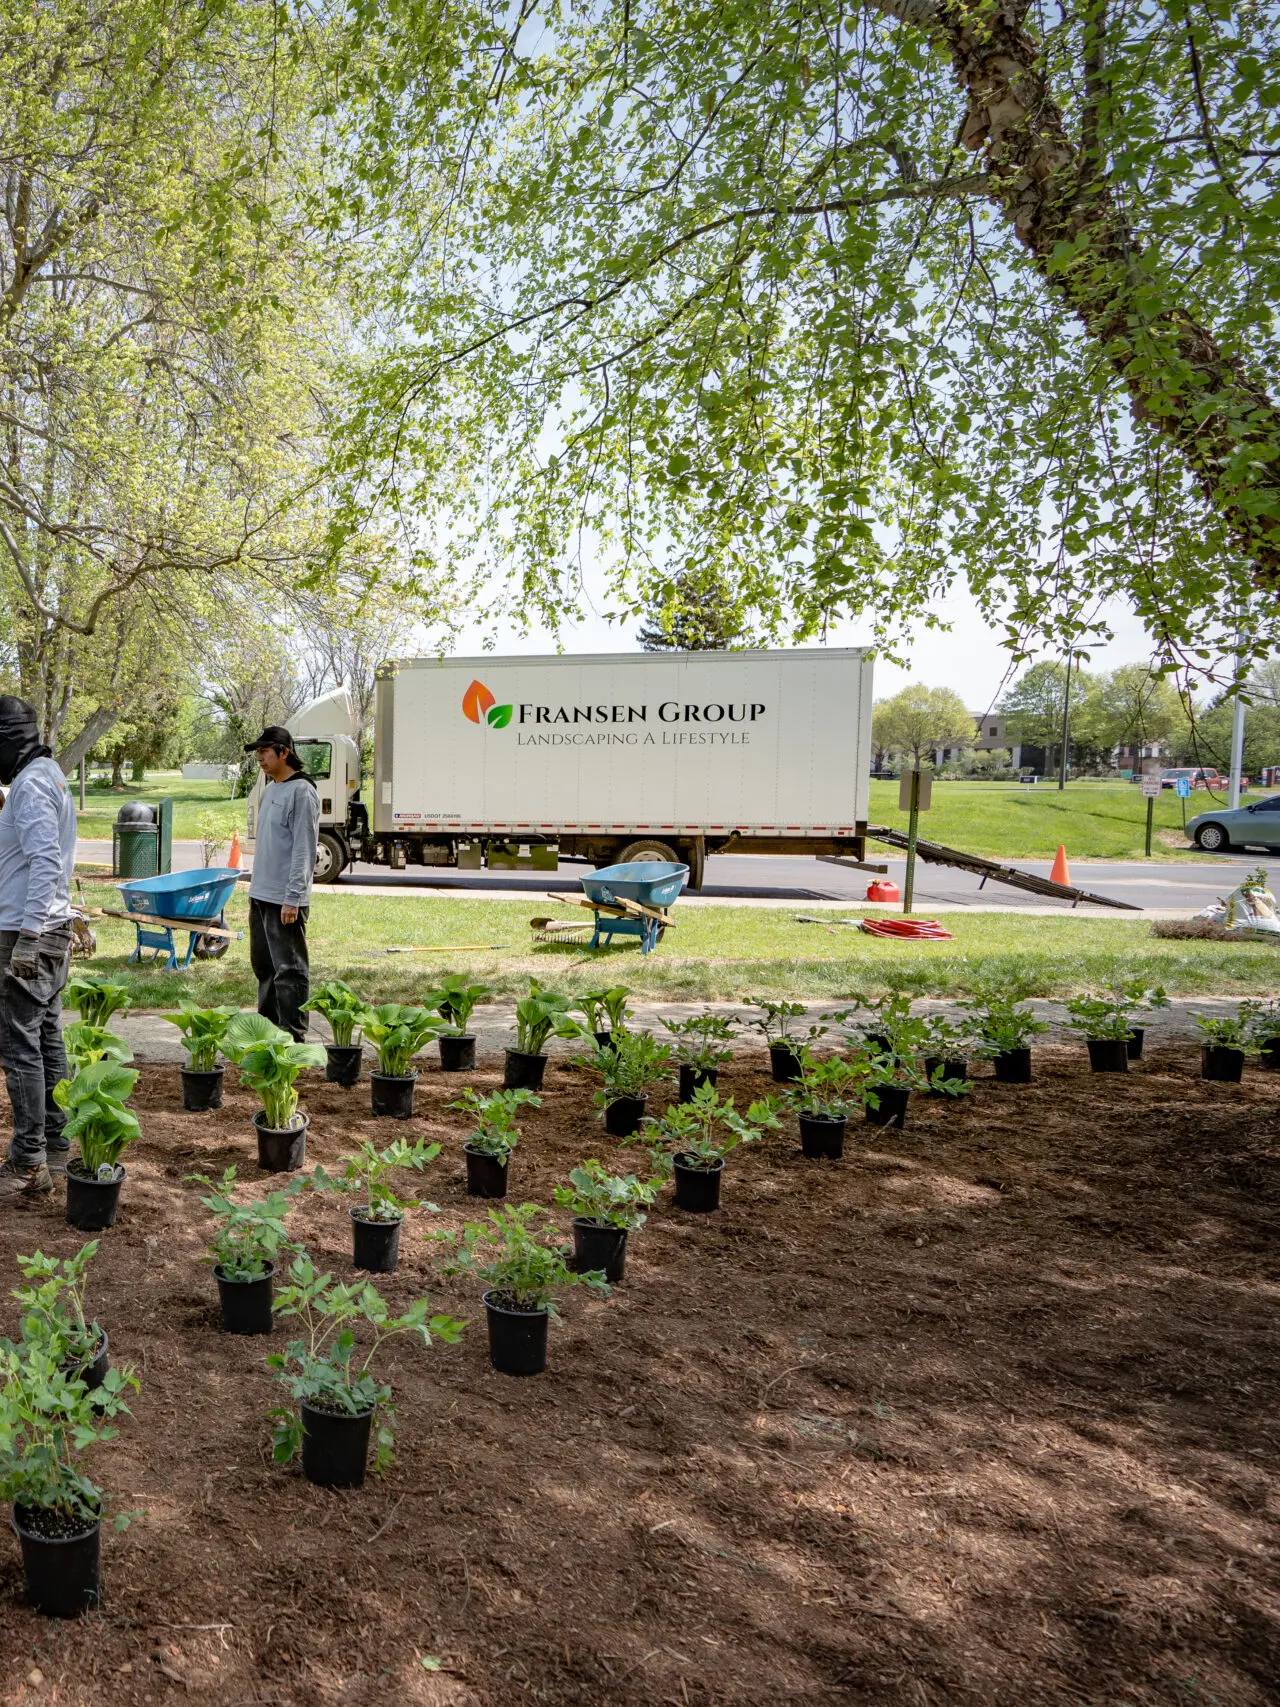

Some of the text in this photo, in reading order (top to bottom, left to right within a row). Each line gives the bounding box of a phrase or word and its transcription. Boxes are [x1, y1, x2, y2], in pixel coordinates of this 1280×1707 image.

[519, 701, 766, 724] FRANSEN GROUP
[517, 731, 751, 746] LANDSCAPING A LIFESTYLE
